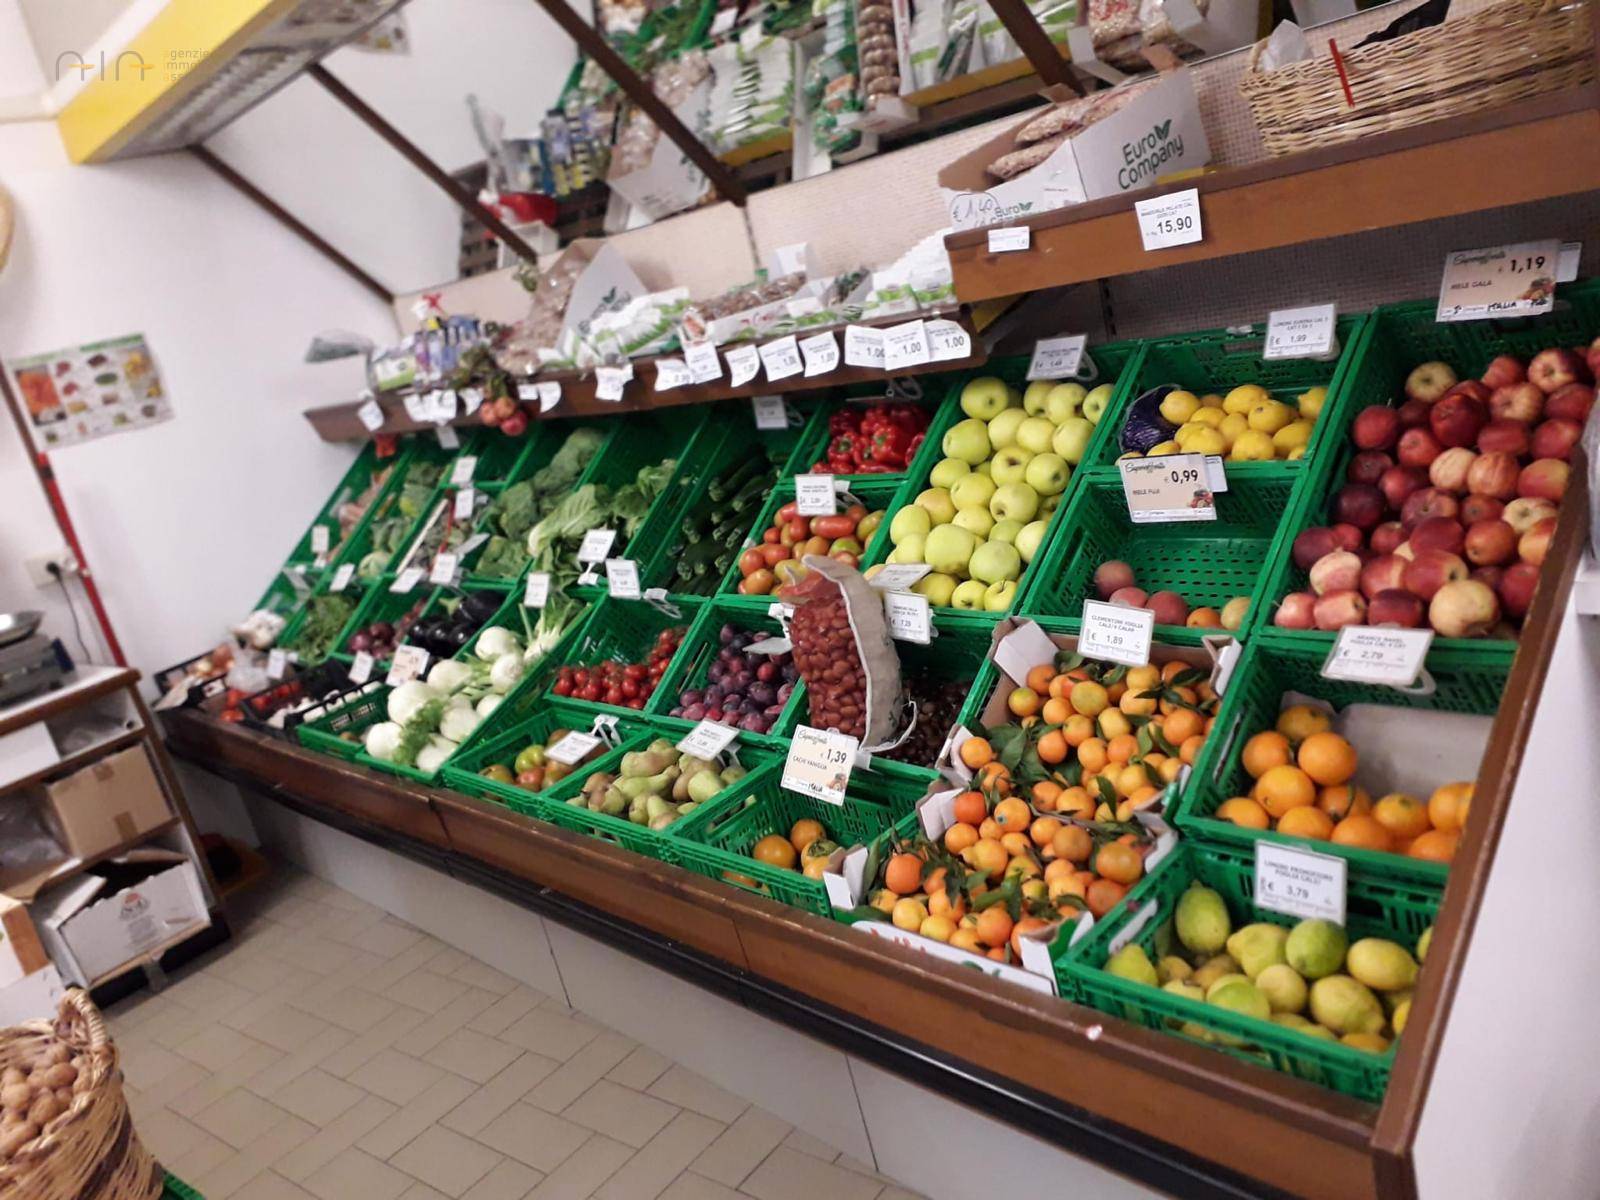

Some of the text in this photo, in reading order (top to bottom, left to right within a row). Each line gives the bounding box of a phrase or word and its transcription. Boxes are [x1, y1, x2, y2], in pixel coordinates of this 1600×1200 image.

[1122, 132, 1157, 166] Euro
[1118, 135, 1184, 190] Company
[1510, 256, 1545, 273] 1,19
[902, 341, 922, 355] 1.00
[1171, 469, 1198, 484] 0,99
[1091, 632, 1097, 641] €
[827, 748, 847, 764] 1,39
